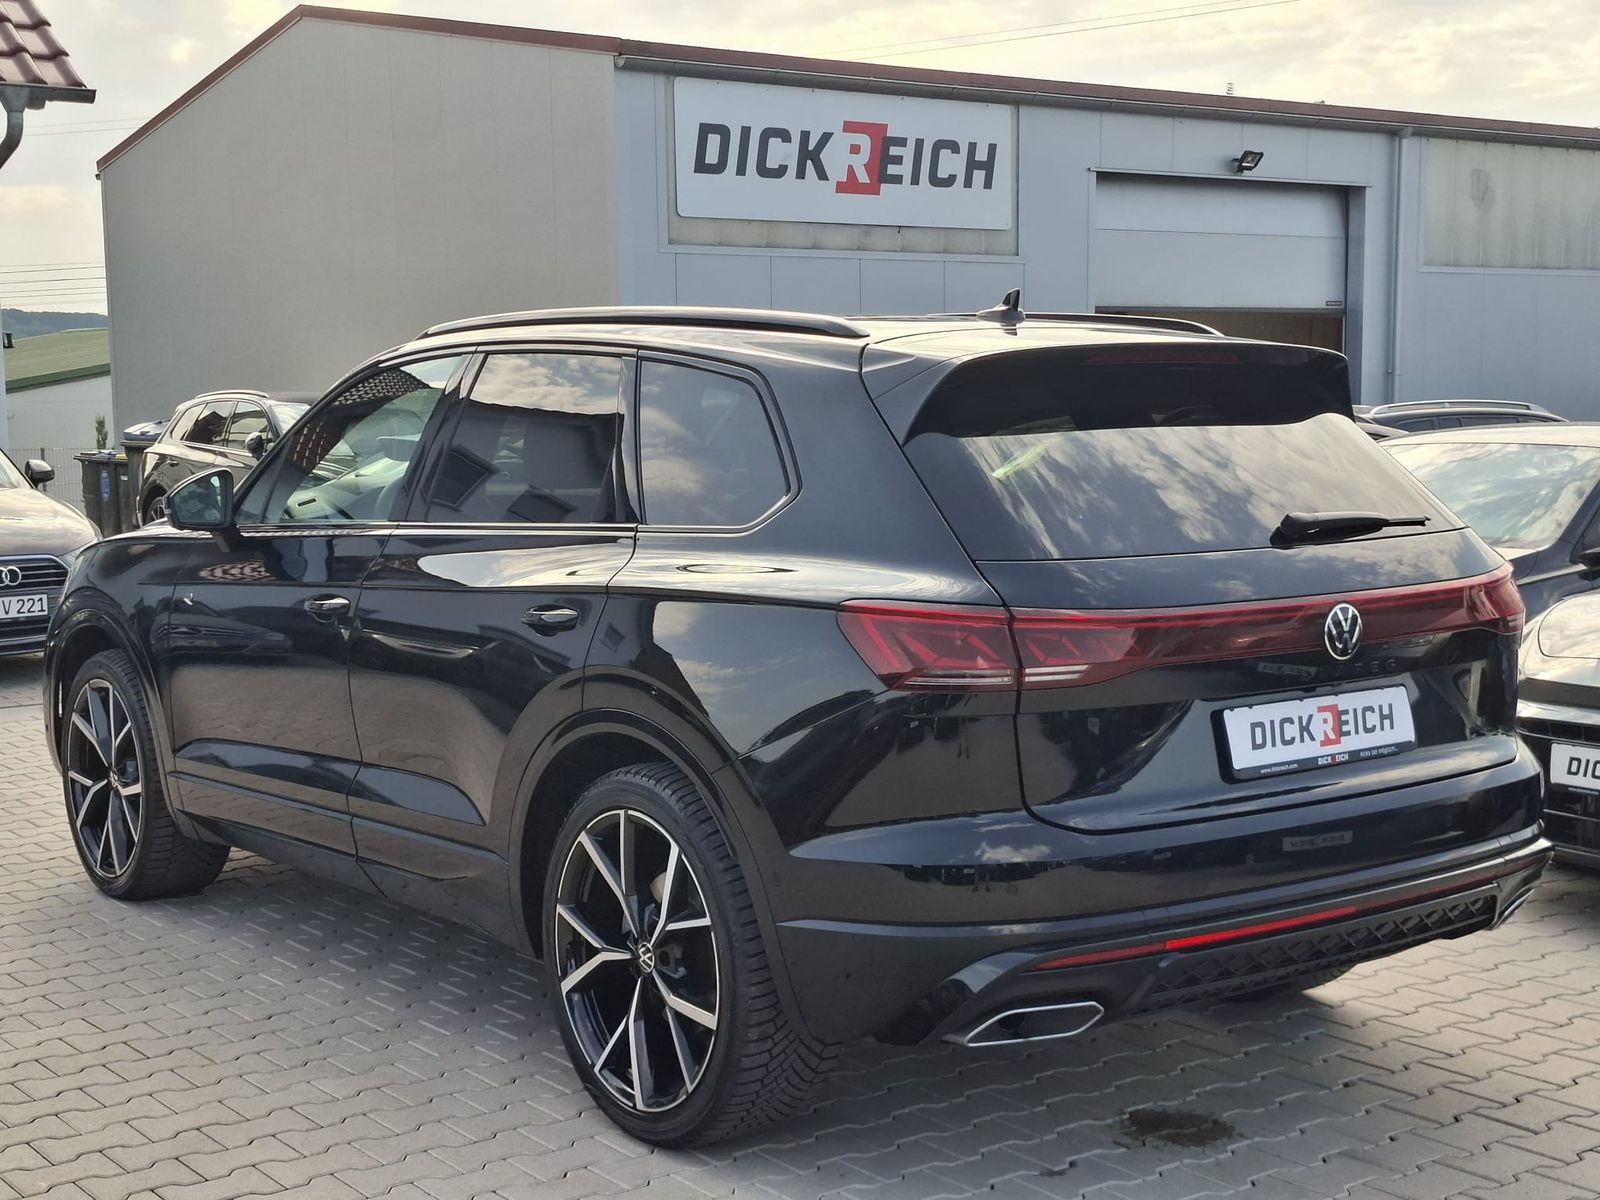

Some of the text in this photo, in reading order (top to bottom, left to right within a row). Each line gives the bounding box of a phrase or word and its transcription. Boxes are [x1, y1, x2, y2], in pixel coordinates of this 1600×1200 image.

[693, 121, 997, 195] DICKREICH
[17, 597, 46, 614] 221
[1250, 703, 1395, 751] DICKREICH
